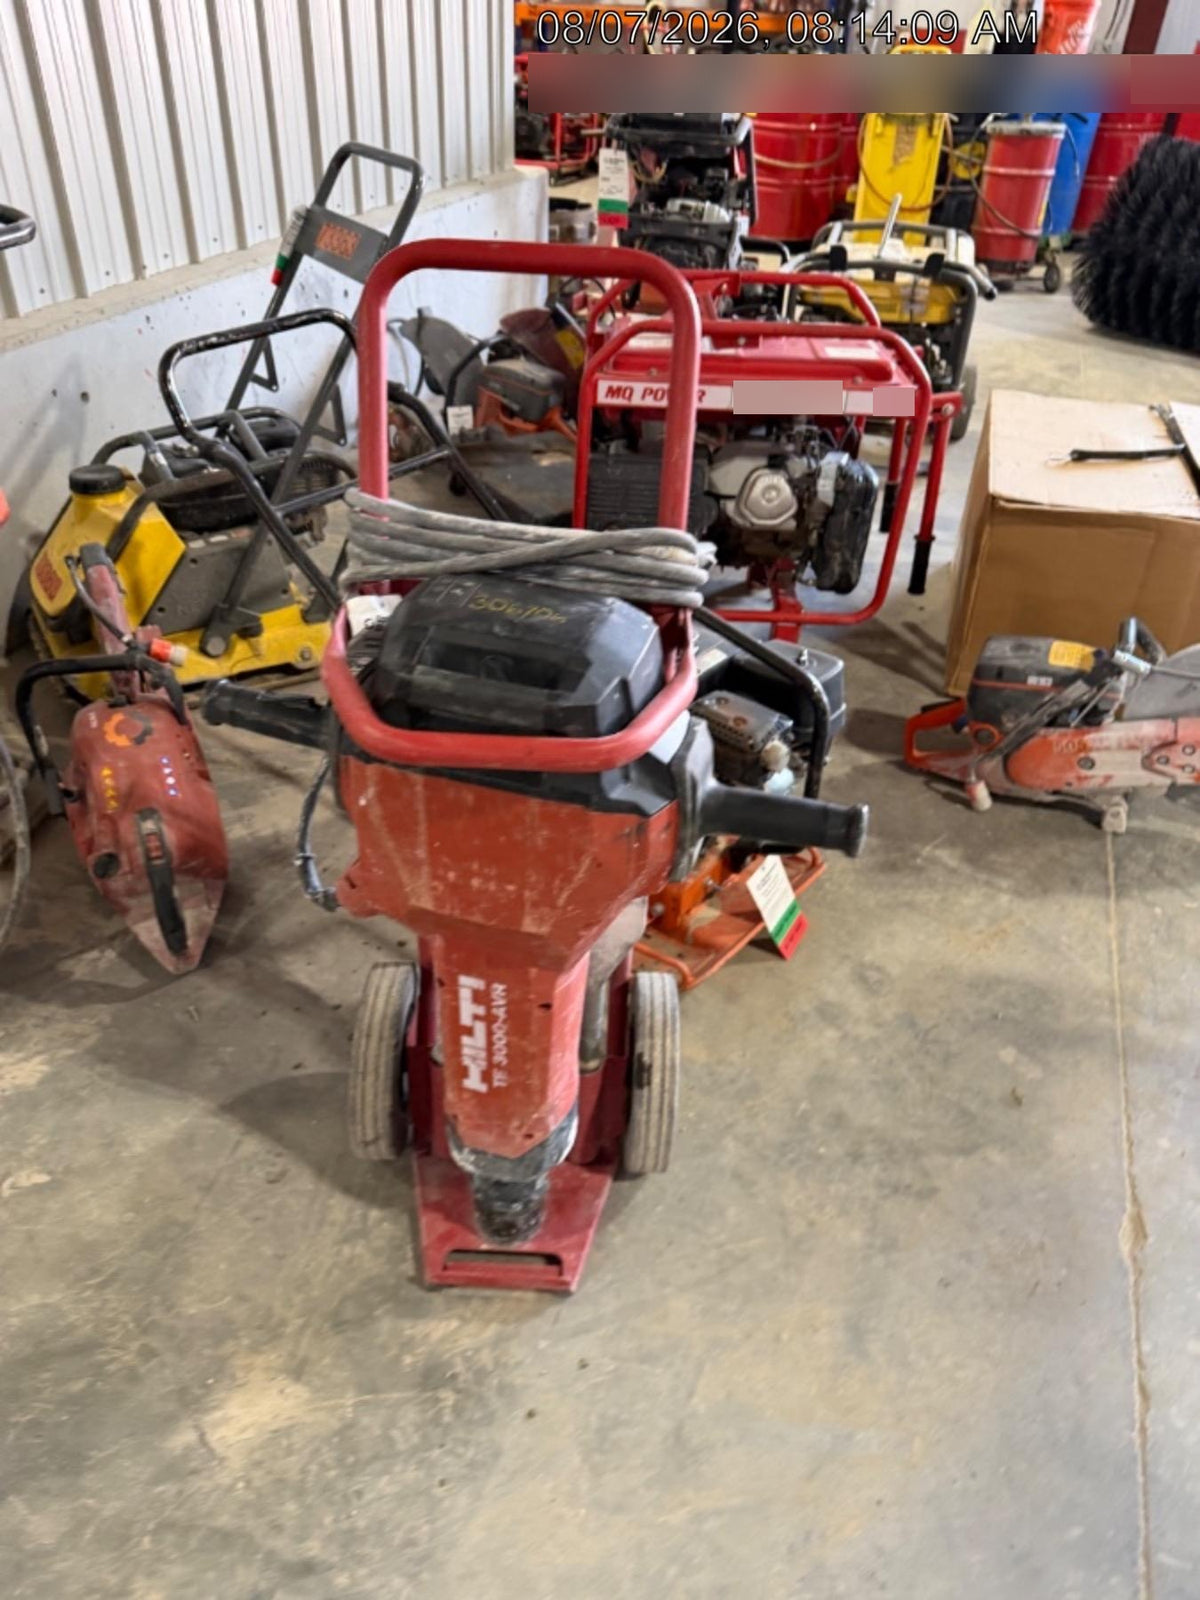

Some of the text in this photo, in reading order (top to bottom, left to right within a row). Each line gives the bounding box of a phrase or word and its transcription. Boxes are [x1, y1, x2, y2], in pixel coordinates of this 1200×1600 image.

[605, 384, 706, 404] MQ POR
[458, 974, 488, 1094] HILTI
